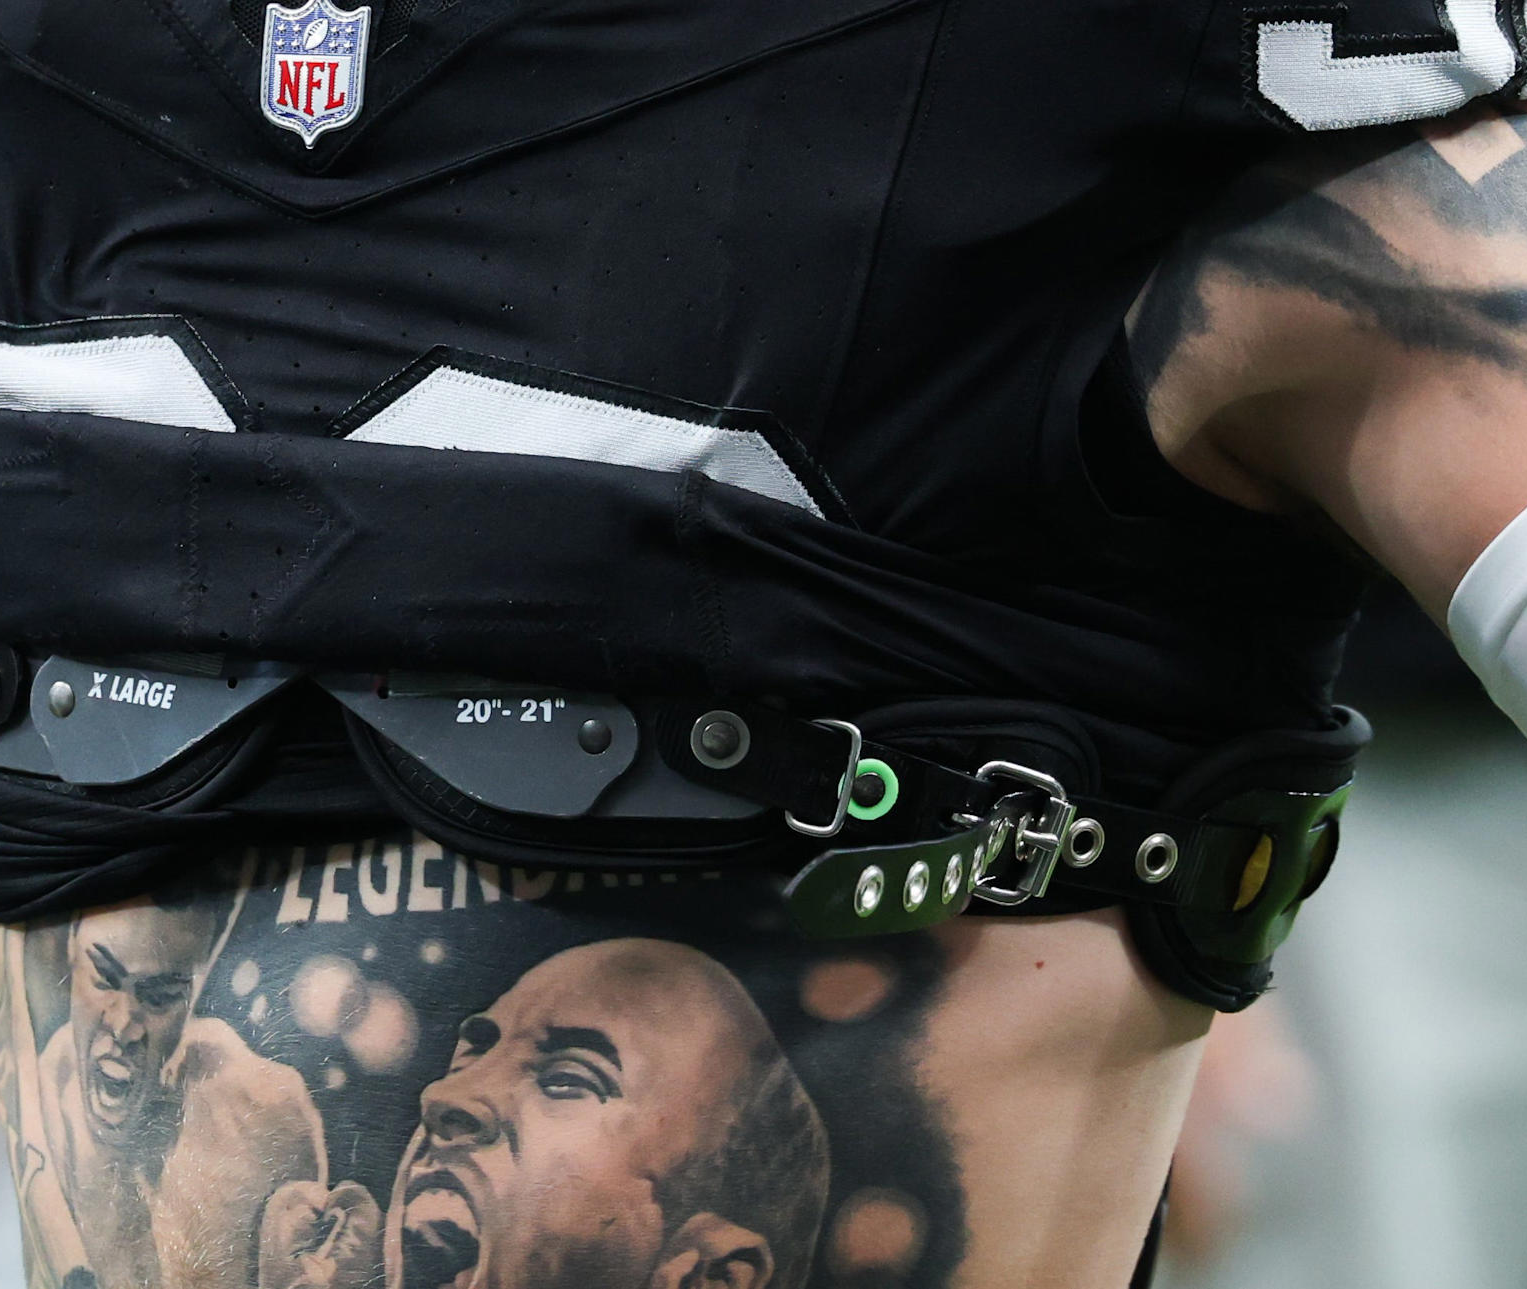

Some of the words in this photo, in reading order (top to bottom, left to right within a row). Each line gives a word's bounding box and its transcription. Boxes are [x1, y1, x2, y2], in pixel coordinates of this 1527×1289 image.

[276, 60, 345, 117] NFL
[87, 672, 108, 699] X
[109, 675, 177, 710] LARGE
